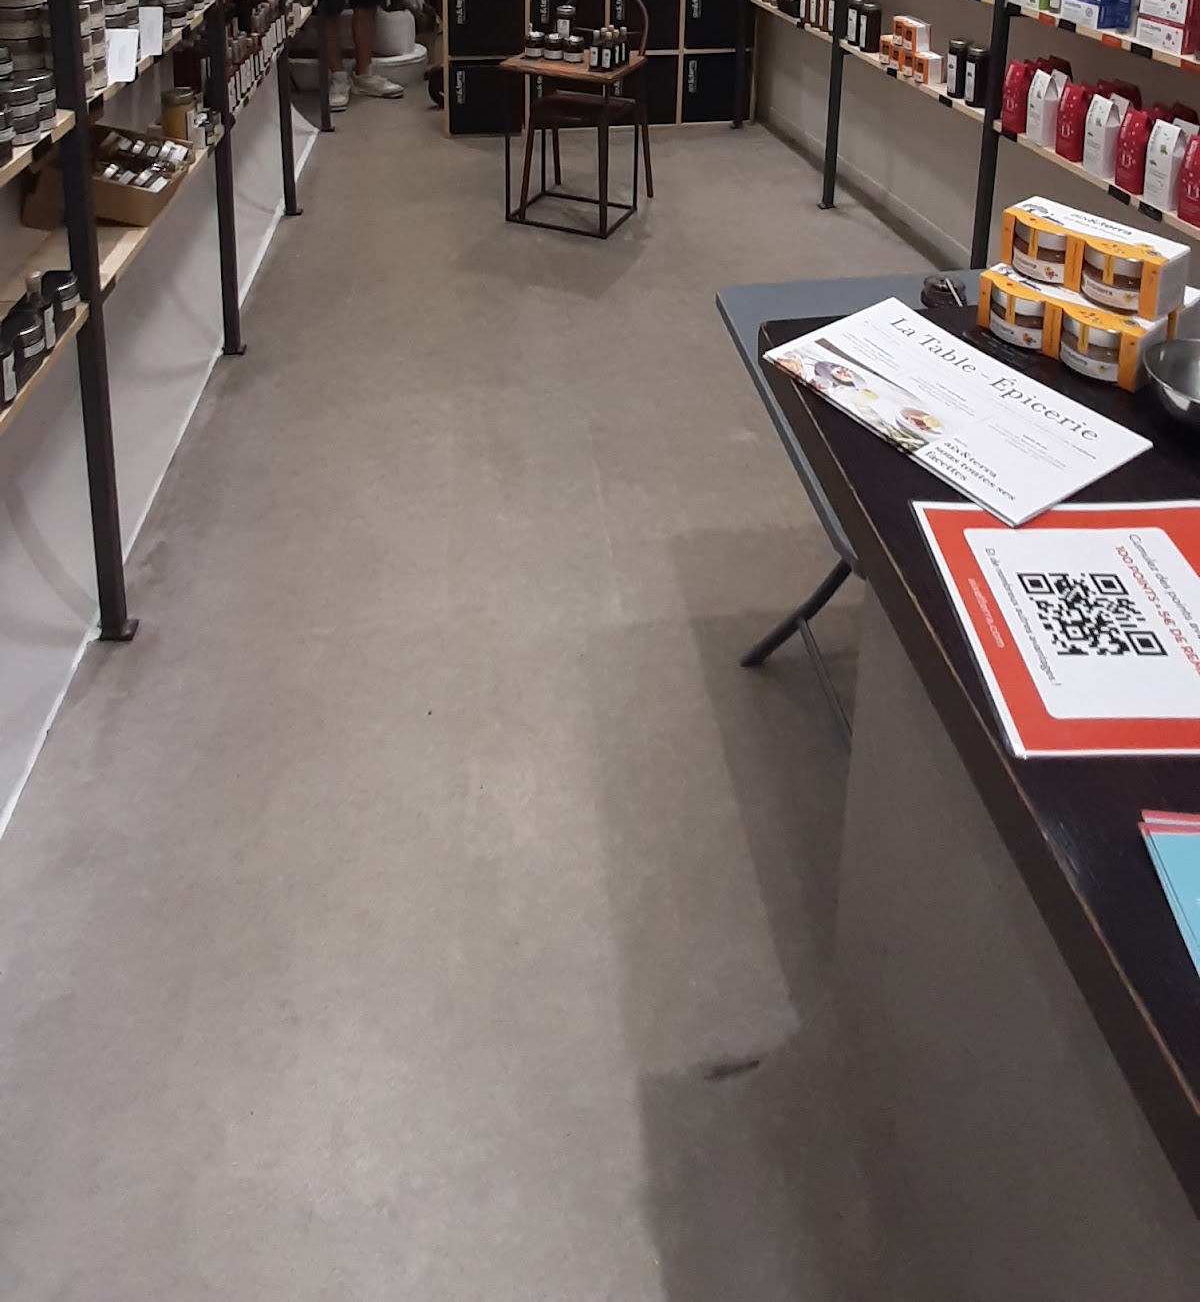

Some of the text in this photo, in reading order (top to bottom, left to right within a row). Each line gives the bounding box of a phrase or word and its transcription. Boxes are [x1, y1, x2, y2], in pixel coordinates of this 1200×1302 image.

[890, 317, 917, 338] La
[919, 332, 979, 375] Table
[989, 377, 1099, 443] Épicerie
[924, 449, 968, 482] facettes
[934, 446, 1017, 501] sous toutes ses
[943, 441, 999, 479] aix&terra
[1115, 545, 1134, 565] 100
[1128, 564, 1161, 604] POINTS
[1168, 627, 1189, 645] DE
[1155, 571, 1172, 590] des
[1165, 591, 1194, 621] points
